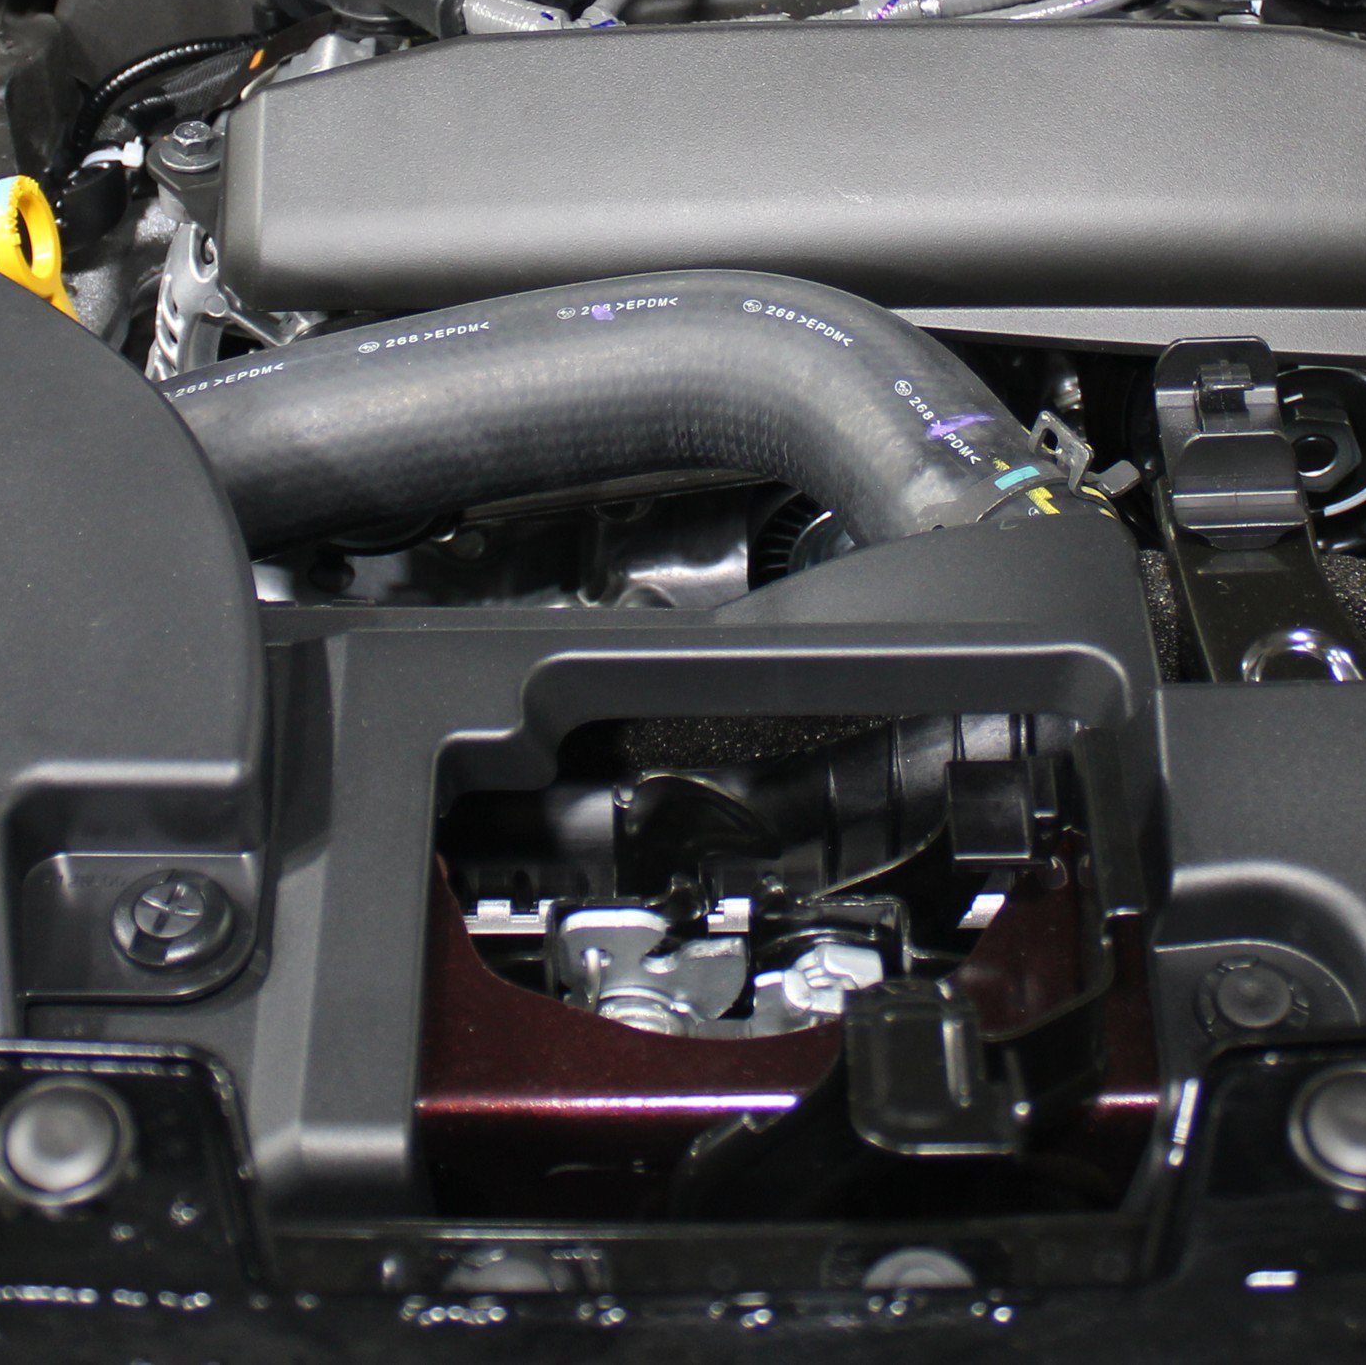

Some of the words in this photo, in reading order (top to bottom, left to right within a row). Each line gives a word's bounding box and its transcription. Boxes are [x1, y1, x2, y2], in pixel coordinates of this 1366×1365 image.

[615, 296, 679, 311] >EPDM<
[385, 334, 419, 348] 268
[424, 320, 490, 341] >EPDM<
[764, 305, 796, 321] 268
[796, 314, 854, 347] >EPDM<
[175, 381, 208, 398] 268
[212, 362, 285, 387] >EPDM<
[908, 396, 935, 421] 268
